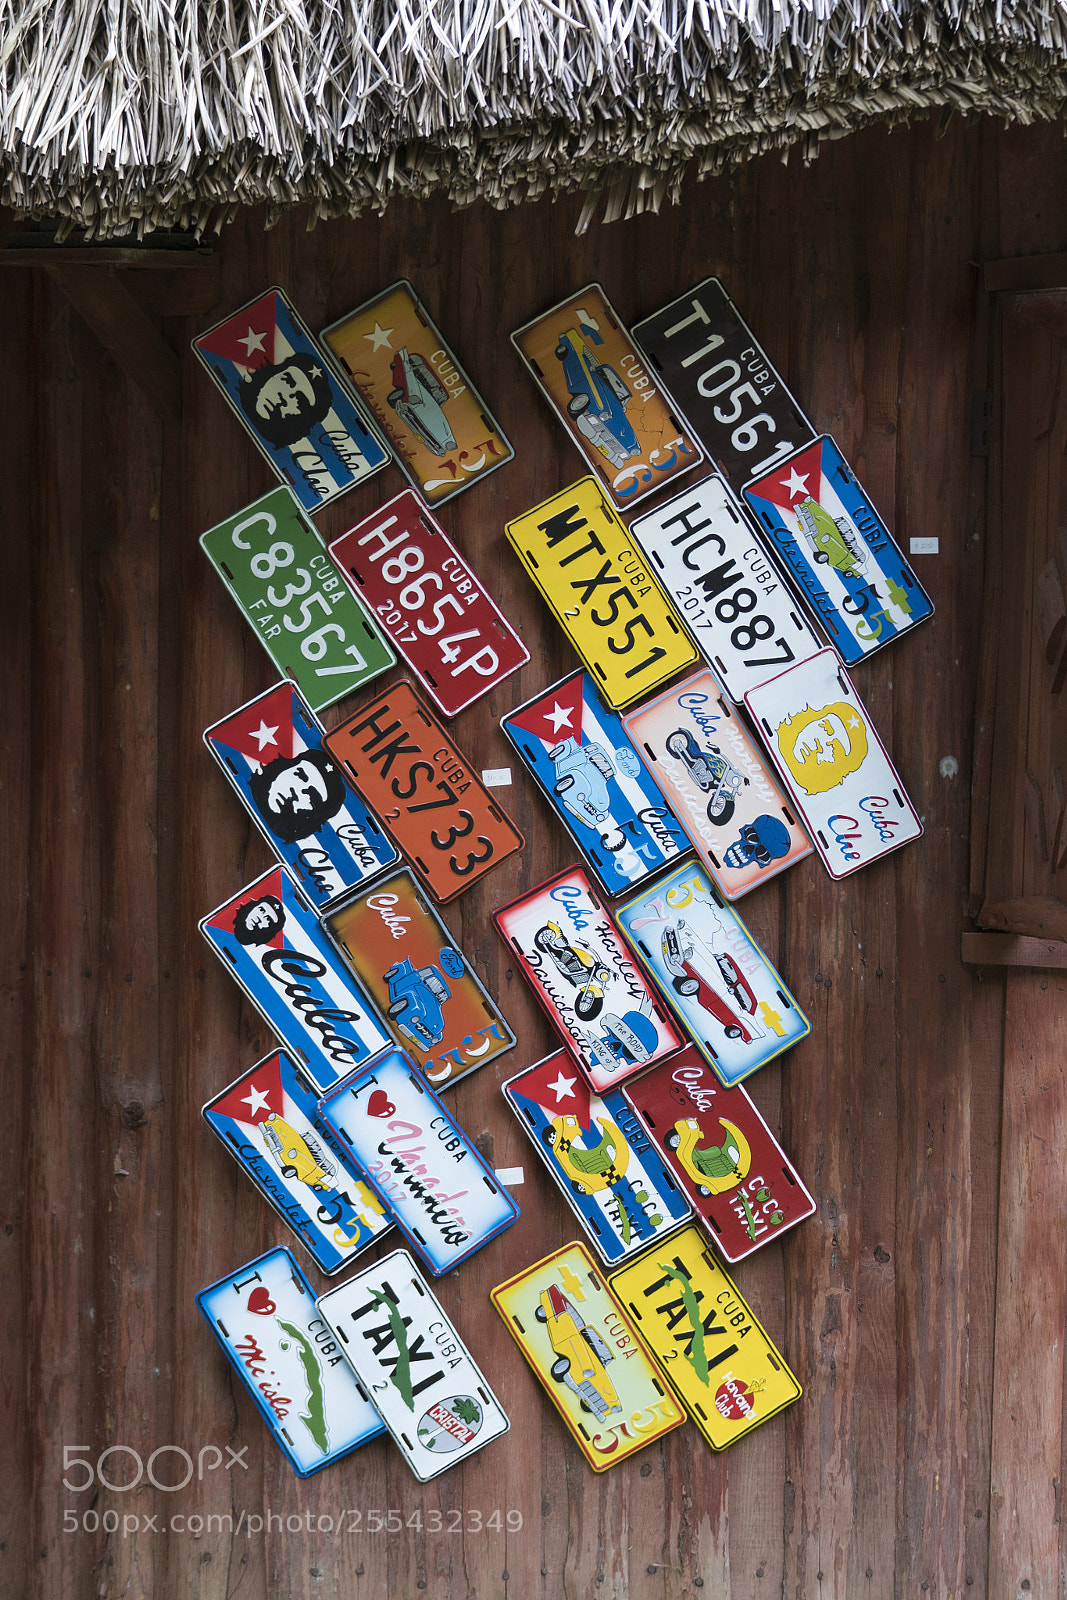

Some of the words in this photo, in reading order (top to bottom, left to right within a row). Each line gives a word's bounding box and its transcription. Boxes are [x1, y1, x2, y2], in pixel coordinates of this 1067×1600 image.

[430, 349, 465, 400] CUBA
[619, 354, 657, 403] CUBA
[663, 299, 794, 475] T10561
[740, 347, 776, 397] CUBA
[292, 450, 329, 498] Che
[318, 433, 361, 475] Cuba
[850, 506, 888, 554] CUBA
[231, 511, 369, 676] C83567
[309, 554, 345, 605] CUBA
[440, 557, 480, 605] CUBA
[537, 504, 667, 678] MTX551
[616, 549, 651, 598] CUBA
[660, 501, 795, 666] HCM887
[742, 547, 777, 596] CUBA
[773, 529, 838, 617] Chevrolet
[248, 598, 281, 639] FAR
[357, 515, 499, 677] H8654P
[563, 607, 580, 622] 2
[674, 585, 712, 628] 2017
[377, 600, 418, 642] 2017
[677, 693, 720, 737] Cuba
[349, 705, 493, 875] HKS733
[432, 748, 471, 795] CUBA
[384, 808, 401, 824] 2
[637, 808, 681, 853] Cuba
[827, 816, 863, 862] Che
[859, 796, 899, 843] Cuba
[336, 825, 381, 868] Cuba
[297, 848, 335, 895] Che
[367, 893, 412, 939] Cuba
[549, 885, 590, 932] Cuba
[595, 922, 646, 999] Harley
[725, 927, 761, 975] CUBA
[261, 950, 361, 1064] Cuba
[591, 1040, 607, 1059] KING
[625, 1033, 643, 1054] ROAD
[671, 1067, 716, 1112] Cuba
[429, 1117, 468, 1163] CUBA
[614, 1108, 650, 1155] CUBA
[349, 1073, 379, 1099] I
[377, 1119, 472, 1246] Varadero
[367, 1159, 407, 1201] 2017
[239, 1146, 311, 1230] Chevrolet
[603, 1194, 643, 1241] TAXI
[728, 1188, 769, 1239] TAXI
[233, 1271, 262, 1294] I
[602, 1312, 638, 1360] CUBA
[643, 1256, 738, 1371] TAXI
[715, 1291, 751, 1338] CUBA
[307, 1319, 342, 1367] CUBA
[350, 1281, 445, 1397] TAXI
[427, 1322, 463, 1369] CUBA
[661, 1349, 678, 1364] 2
[235, 1333, 275, 1377] Mi
[260, 1381, 292, 1420] isla
[372, 1379, 388, 1393] 2
[719, 1371, 756, 1421] Havana
[429, 1405, 473, 1444] CRISTAL
[713, 1394, 734, 1418] Club
